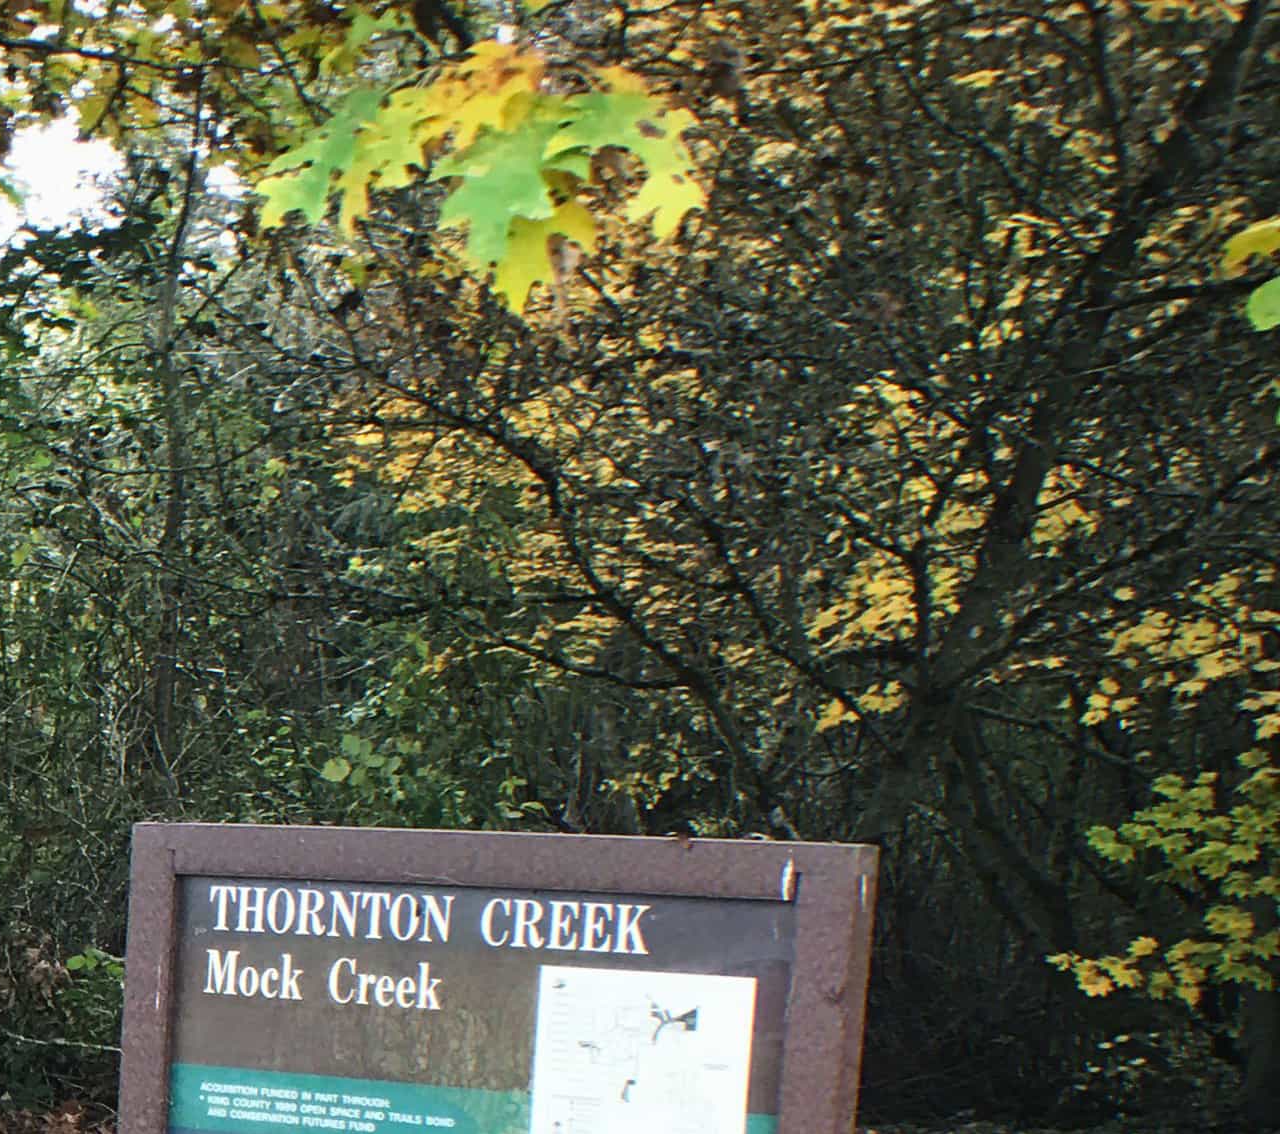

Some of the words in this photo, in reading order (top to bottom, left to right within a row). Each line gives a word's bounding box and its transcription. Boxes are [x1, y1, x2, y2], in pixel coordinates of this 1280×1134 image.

[209, 884, 456, 944] THORNTON
[480, 898, 651, 955] CREEK
[203, 948, 304, 1001] Mock
[328, 957, 442, 1010] Creek
[199, 1082, 258, 1097] ACQUISITION
[260, 1087, 298, 1100] FUNDED
[302, 1090, 313, 1102] IN
[315, 1091, 339, 1103] PART
[207, 1096, 229, 1107] KING
[233, 1097, 271, 1110] COUNTY
[300, 1103, 327, 1115] OPEN
[330, 1105, 361, 1119] SPACE
[364, 1109, 385, 1121] AND
[388, 1111, 422, 1125] TRAILS
[207, 1107, 227, 1119] AND
[229, 1109, 300, 1125] CONSERVATION
[302, 1116, 346, 1130] FUTURES
[349, 1120, 376, 1132] FUND
